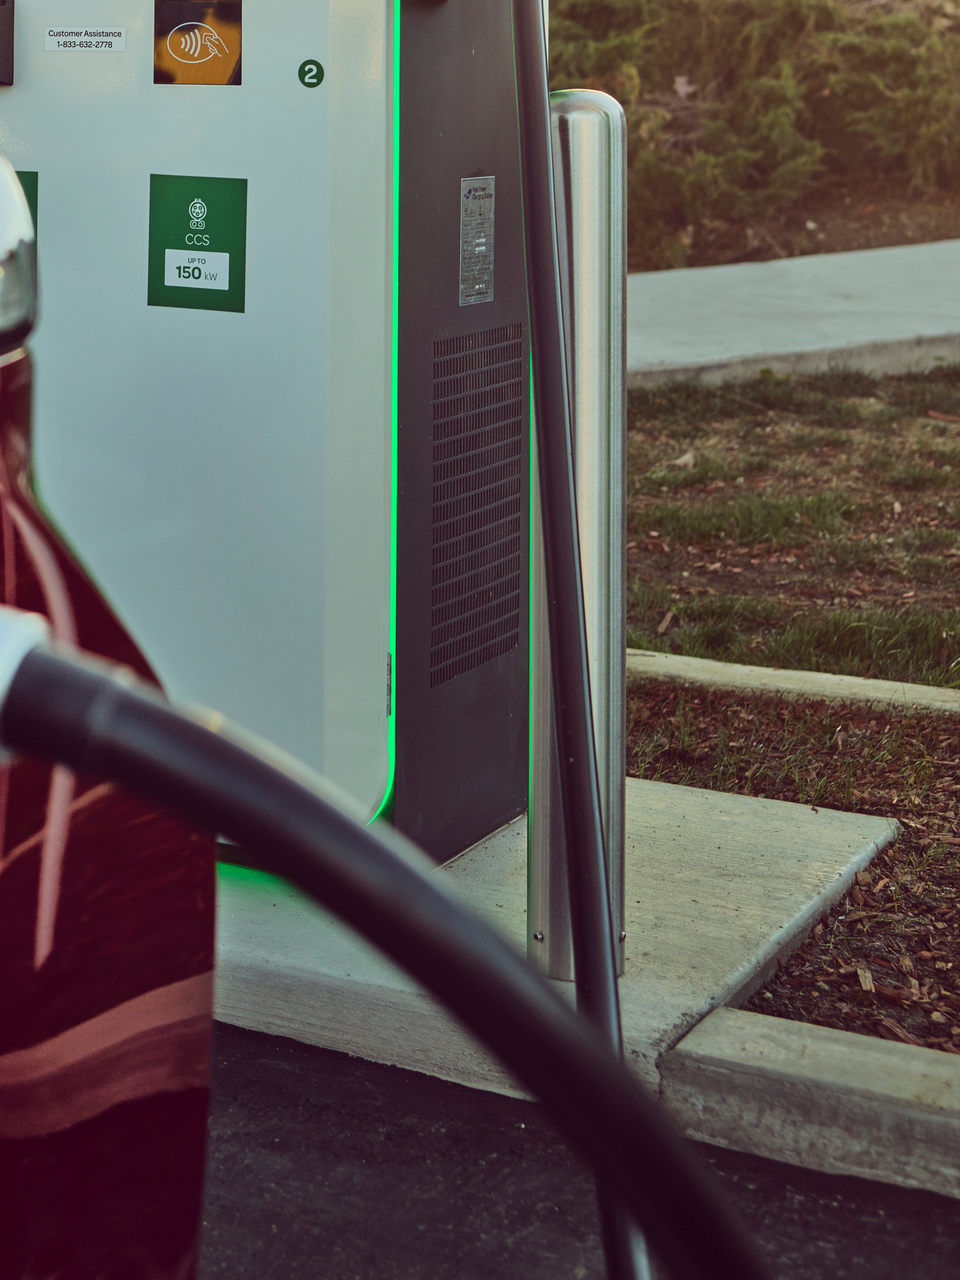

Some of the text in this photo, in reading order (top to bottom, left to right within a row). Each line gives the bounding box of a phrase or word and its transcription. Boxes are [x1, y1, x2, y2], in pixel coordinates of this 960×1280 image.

[48, 29, 122, 38] Customer Assistance
[57, 40, 113, 49] 1-833-632-2778
[304, 64, 318, 83] 2
[185, 233, 210, 246] CCS
[176, 265, 218, 281] 150 kW
